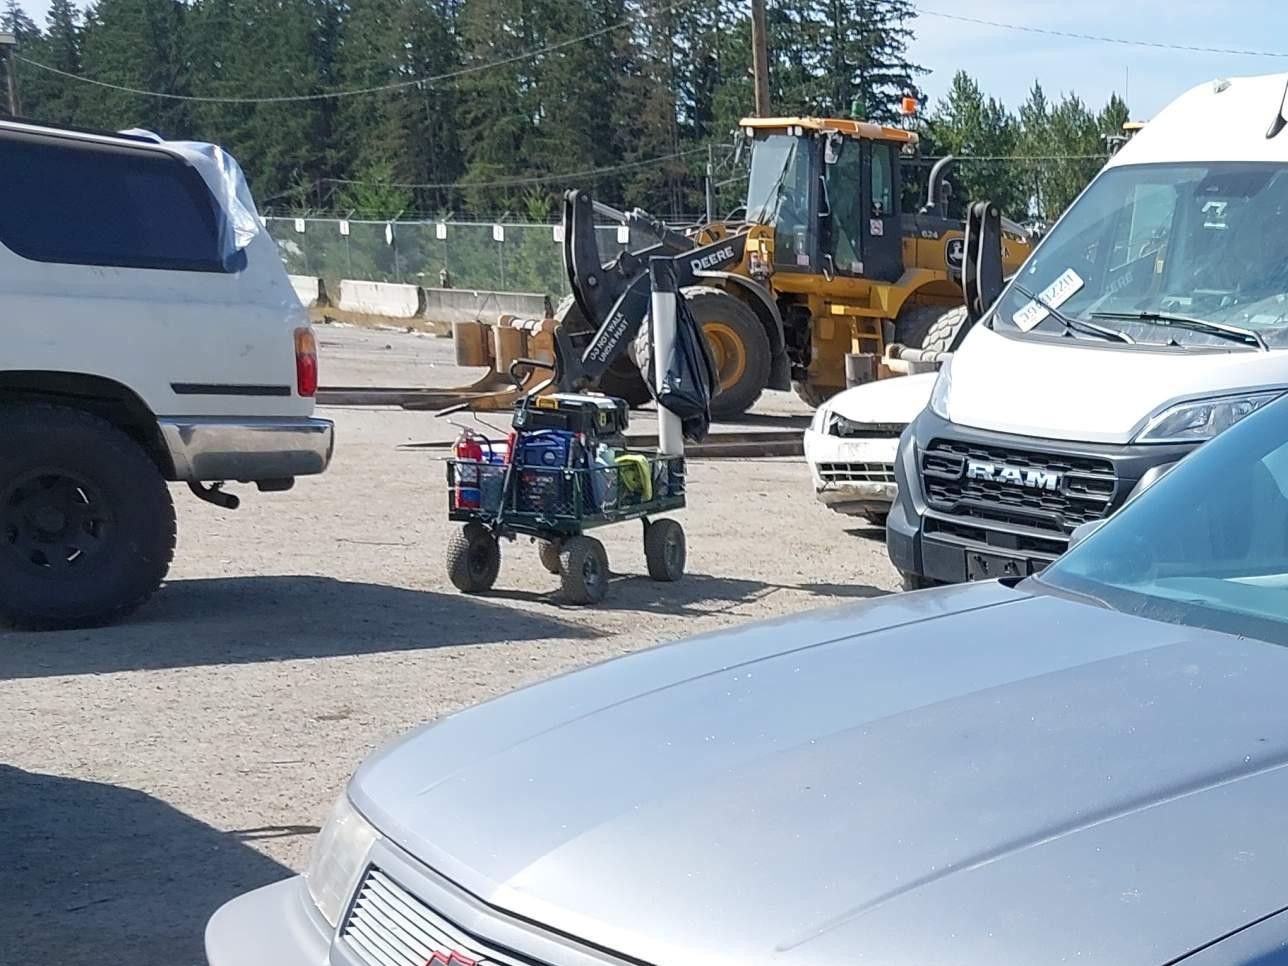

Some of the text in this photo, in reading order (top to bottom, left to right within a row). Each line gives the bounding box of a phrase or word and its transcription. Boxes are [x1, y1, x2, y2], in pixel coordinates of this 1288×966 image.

[690, 246, 735, 272] DEERE
[590, 312, 625, 361] DO NOT WALK
[599, 320, 630, 363] UNDER MAST
[966, 461, 1059, 491] RAM
